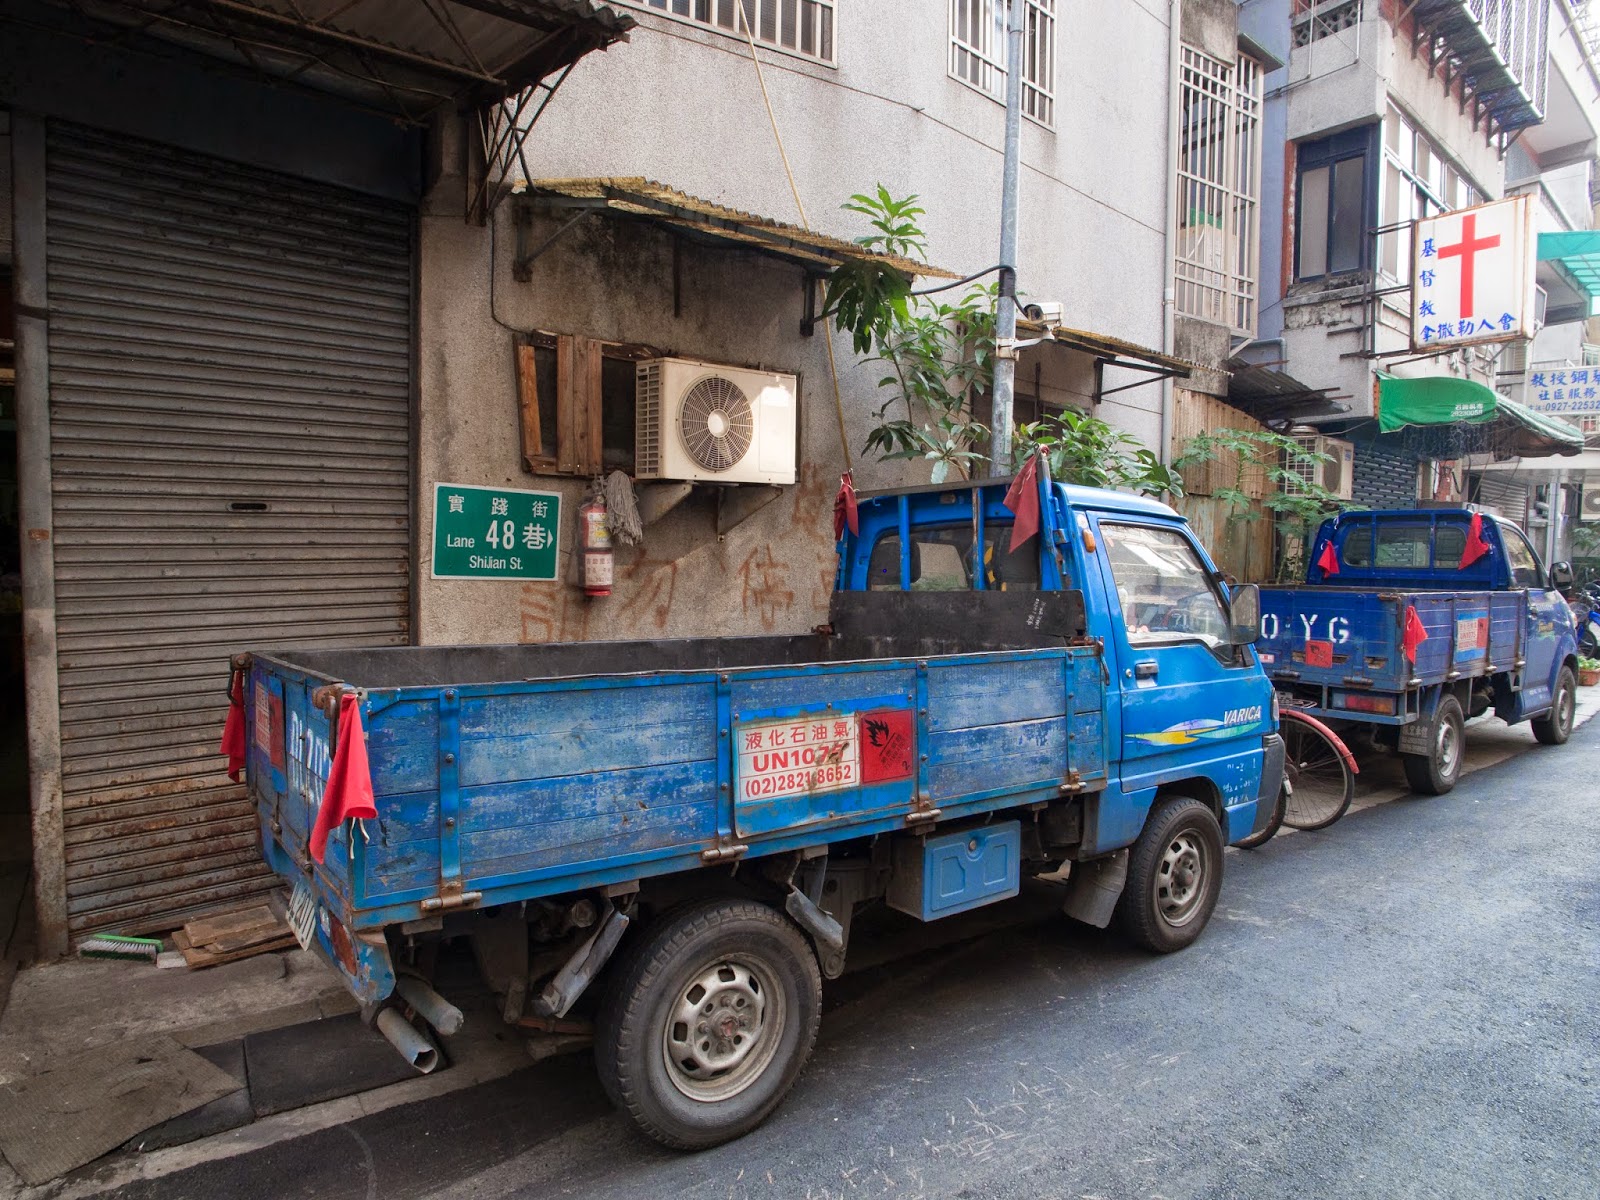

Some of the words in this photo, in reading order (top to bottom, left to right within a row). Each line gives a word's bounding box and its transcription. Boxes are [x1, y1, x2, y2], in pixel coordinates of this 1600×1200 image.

[1419, 238, 1437, 317] 基督教
[1419, 312, 1517, 342] 拿撒勒人會
[1538, 387, 1597, 401] 社區服務
[448, 494, 548, 518] 實踐街
[447, 534, 475, 548] Lane
[485, 520, 515, 550] 48
[522, 523, 546, 550] 巷
[509, 557, 524, 569] St.
[1224, 705, 1262, 725] VARICA
[745, 721, 850, 750] 液化石油氣
